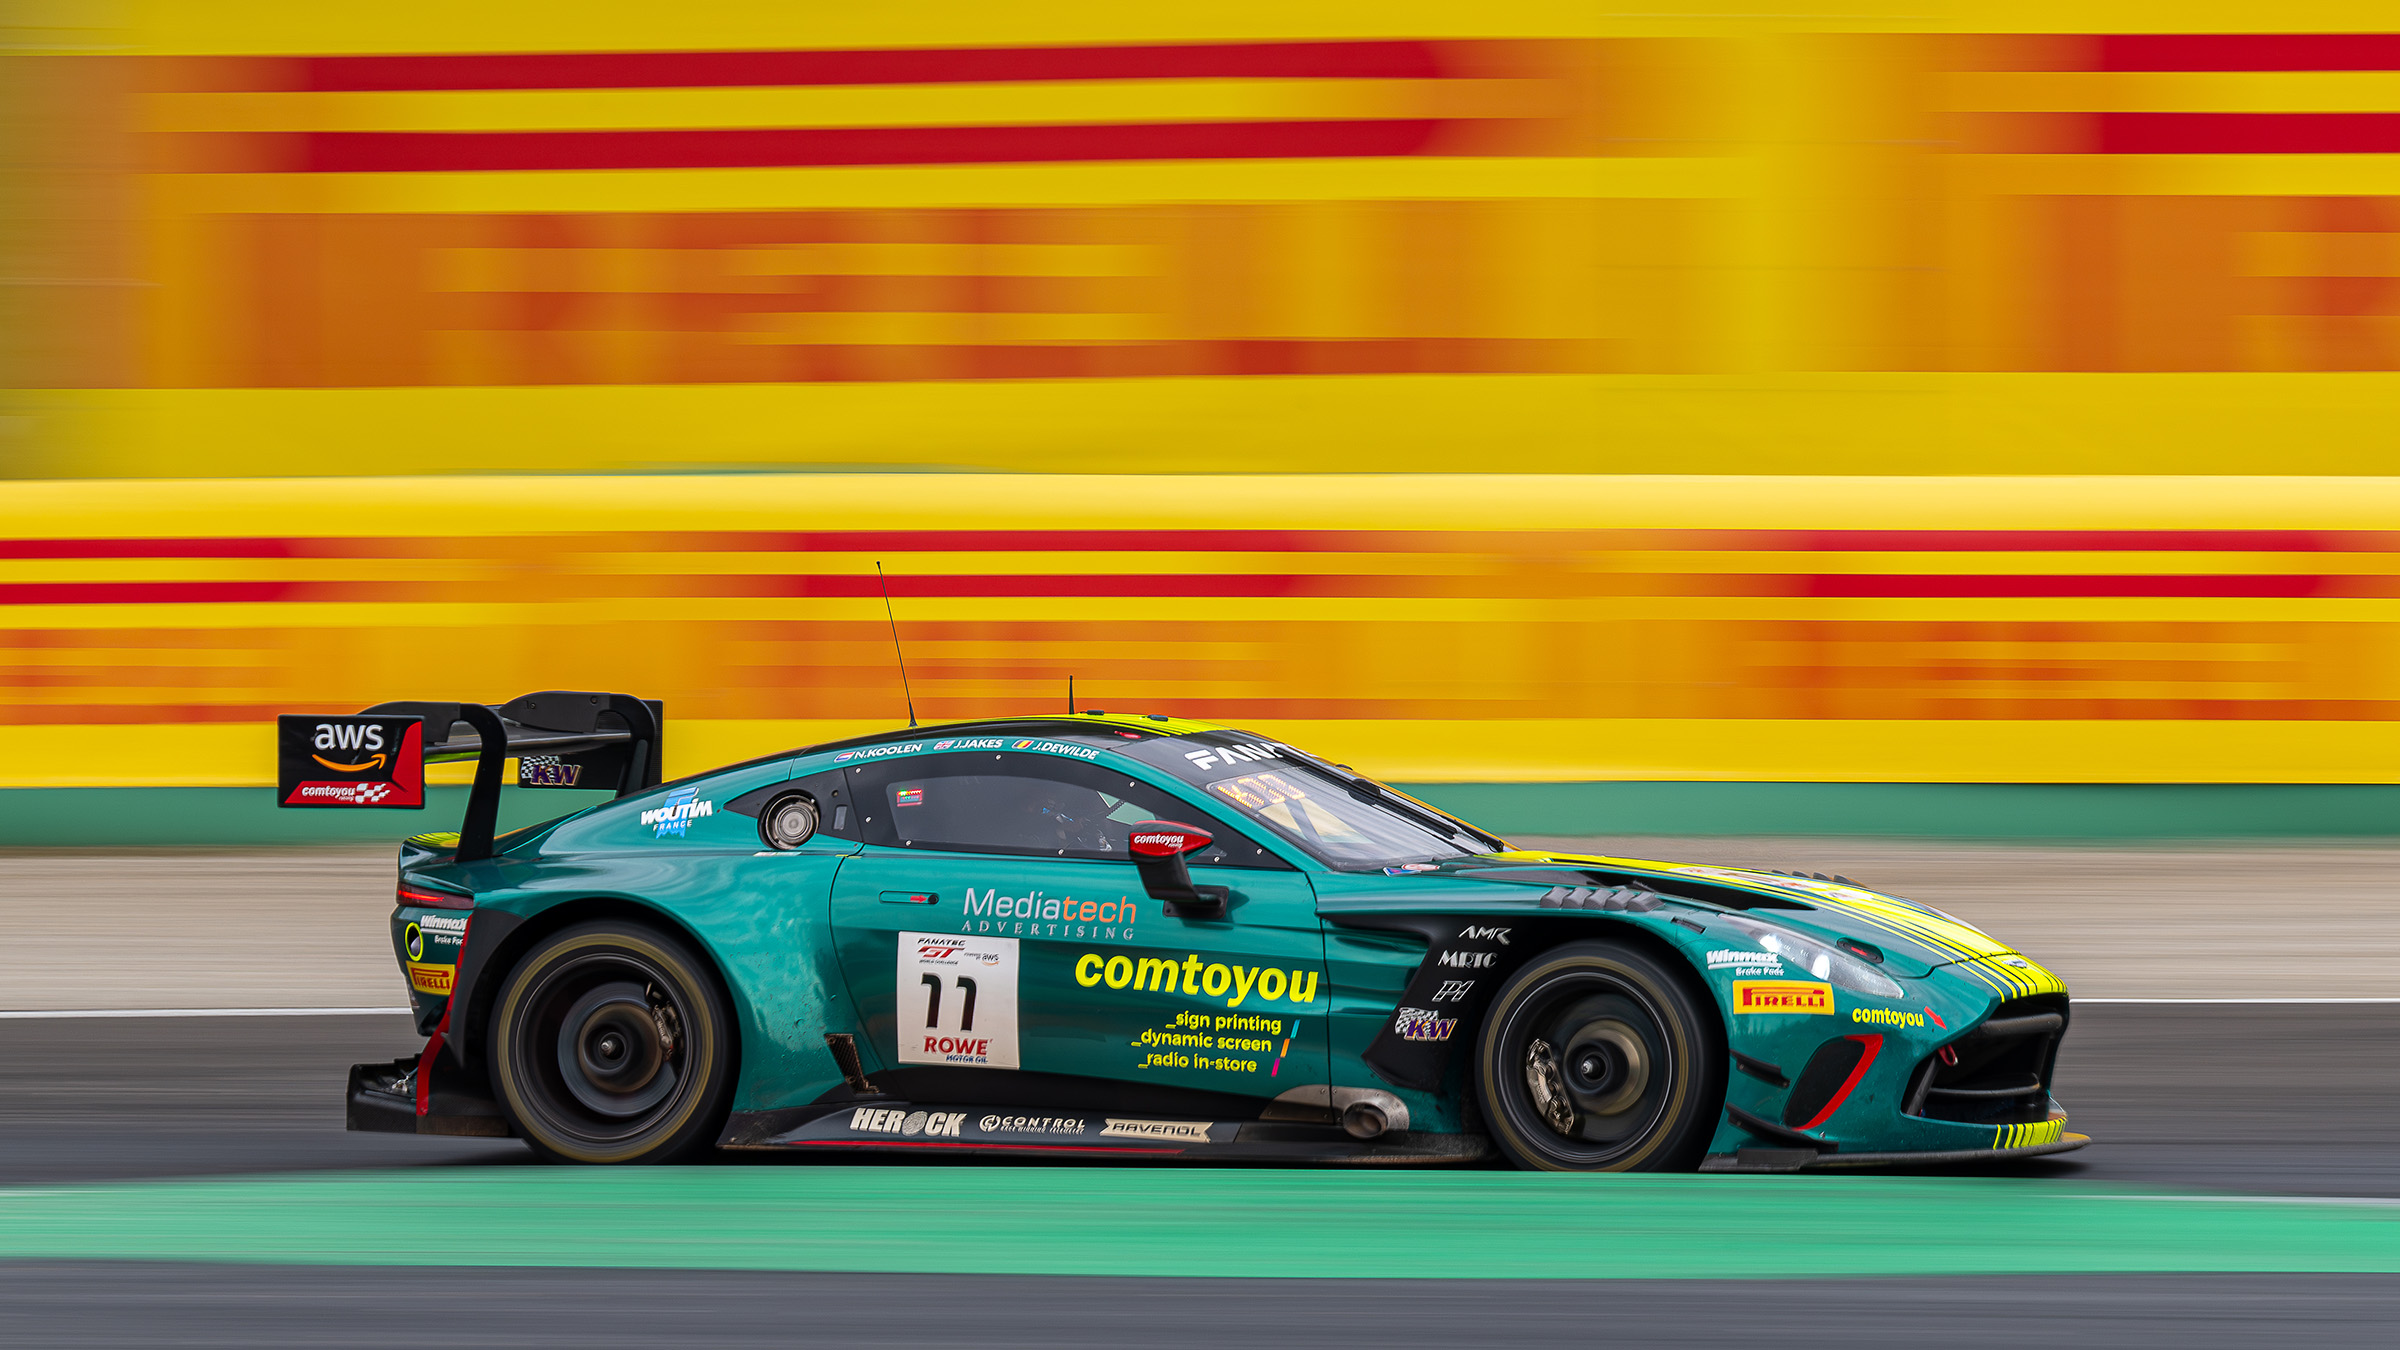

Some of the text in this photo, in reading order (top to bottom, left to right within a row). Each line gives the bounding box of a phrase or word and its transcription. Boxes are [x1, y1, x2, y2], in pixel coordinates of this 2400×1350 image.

[314, 723, 385, 751] aws
[953, 739, 1003, 750] J.JAKES
[854, 744, 923, 760] N.KOOLEN
[1032, 741, 1100, 760] J.DEWILDE
[530, 764, 583, 786] KW
[301, 785, 356, 799] comtoyou
[653, 818, 693, 831] FRANCE
[1134, 834, 1184, 846] comtoyou
[963, 888, 1136, 924] Mediatech
[962, 919, 1133, 940] ADVERTISING
[1458, 925, 1512, 945] AMR
[917, 938, 967, 947] FANATEC
[918, 946, 966, 959] GT
[982, 953, 999, 962] aws
[1438, 950, 1498, 968] MRTC
[1706, 949, 1779, 965] Winmax
[411, 967, 451, 990] PIRELLI
[1736, 966, 1785, 976] Brake Pads
[1075, 953, 1319, 1008] comtoyou
[920, 972, 977, 1032] 11
[1742, 987, 1825, 1007] PIRELLI
[1215, 1013, 1282, 1035] printing
[1852, 1007, 1925, 1029] comtoyou
[1404, 1018, 1458, 1041] KW
[923, 1036, 989, 1056] ROWE
[1217, 1040, 1272, 1052] screen
[946, 1055, 989, 1064] MOTOR OIL
[1194, 1053, 1257, 1072] in-store
[1002, 1116, 1086, 1129] CONTROL
[1112, 1122, 1201, 1137] RAVENOL
